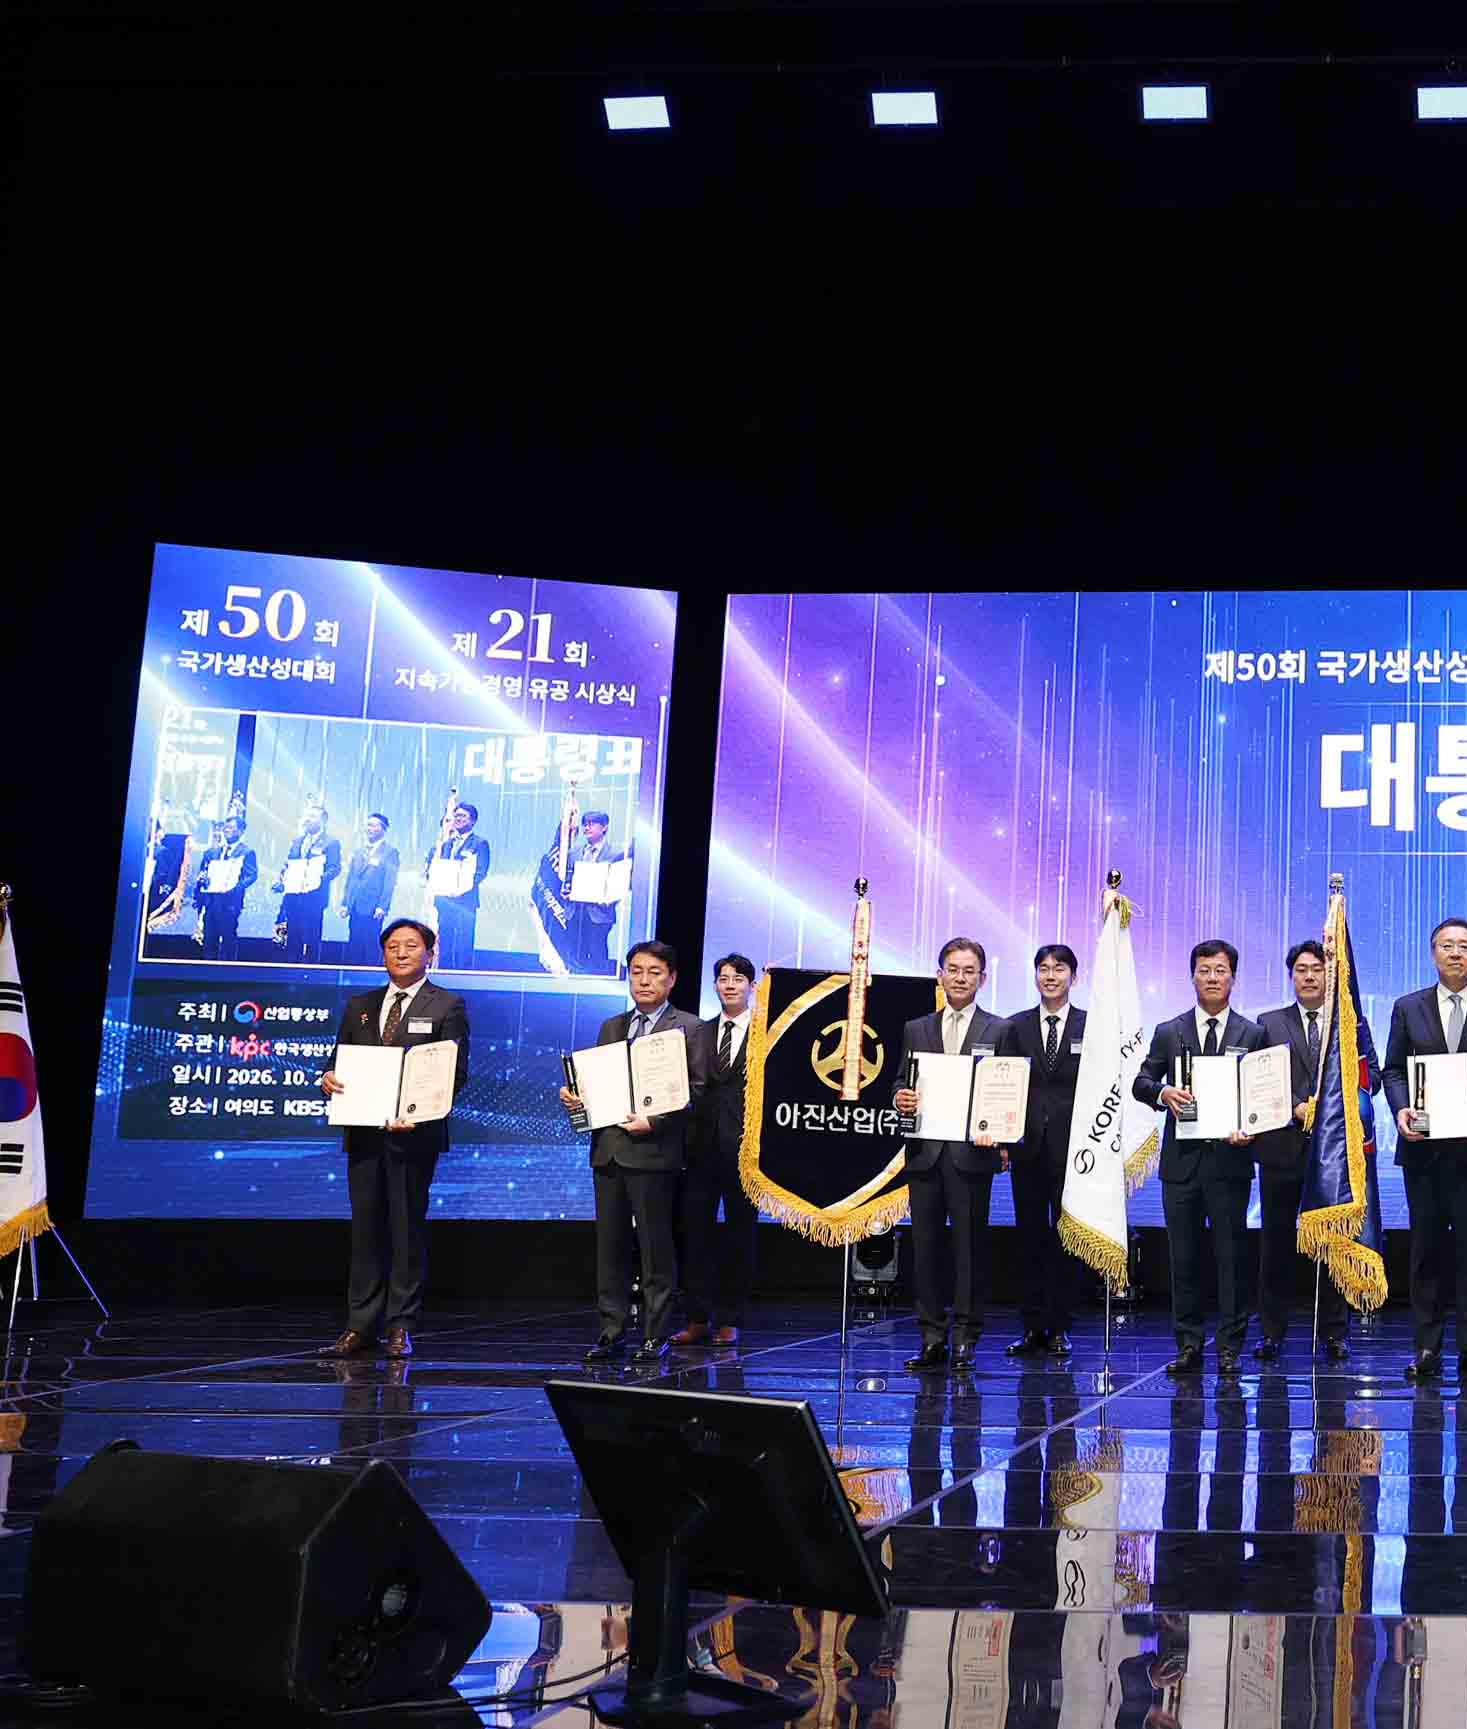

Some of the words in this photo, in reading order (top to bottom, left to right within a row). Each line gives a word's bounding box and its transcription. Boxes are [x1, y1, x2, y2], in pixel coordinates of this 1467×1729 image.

[180, 608, 210, 637] 제
[217, 584, 307, 642] 50
[313, 619, 339, 648] 회
[452, 632, 478, 659] 제
[486, 608, 556, 664] 21
[563, 641, 588, 668] 회
[176, 649, 337, 684] 국가생산성대회
[1204, 649, 1306, 684] 제50회
[395, 666, 523, 698] 지속가경영
[528, 679, 570, 702] 유공
[574, 681, 637, 708] 시상식
[177, 1002, 218, 1022] 주최
[174, 1032, 215, 1054] 주관
[171, 1064, 212, 1085] 일시
[227, 1068, 277, 1086] 2026.
[283, 1070, 309, 1086] 10.
[168, 1095, 208, 1116] 장소
[224, 1098, 276, 1116] 여의도
[775, 1102, 904, 1136] 아진산업(주
